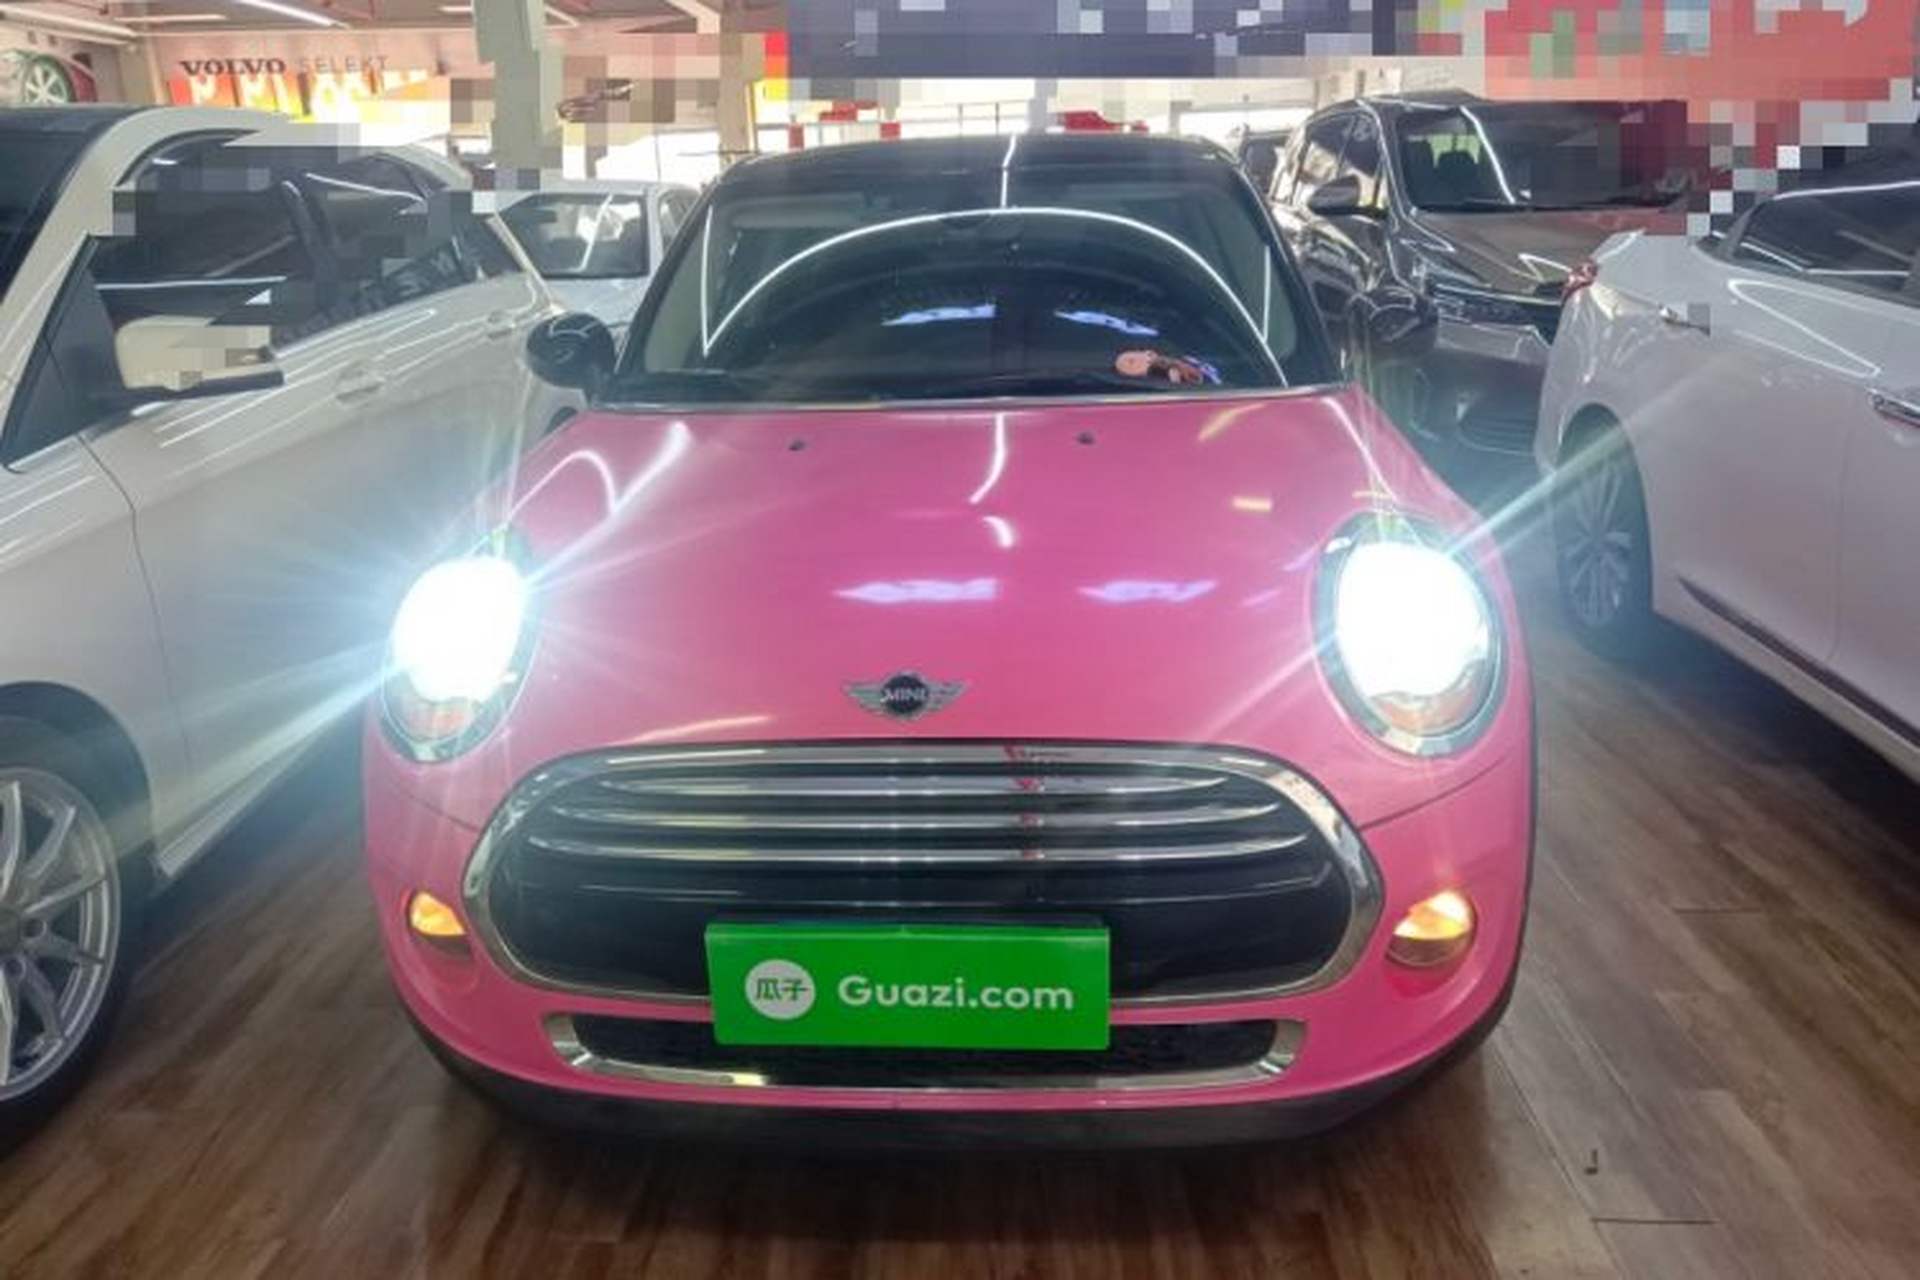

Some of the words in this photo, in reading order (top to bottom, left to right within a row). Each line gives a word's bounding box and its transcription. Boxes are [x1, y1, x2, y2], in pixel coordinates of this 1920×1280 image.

[180, 58, 287, 76] VOLVO
[299, 55, 388, 73] SELEKT
[884, 687, 928, 701] MINI
[756, 978, 809, 1001] 瓜子
[838, 975, 1074, 1010] Guazi.com
